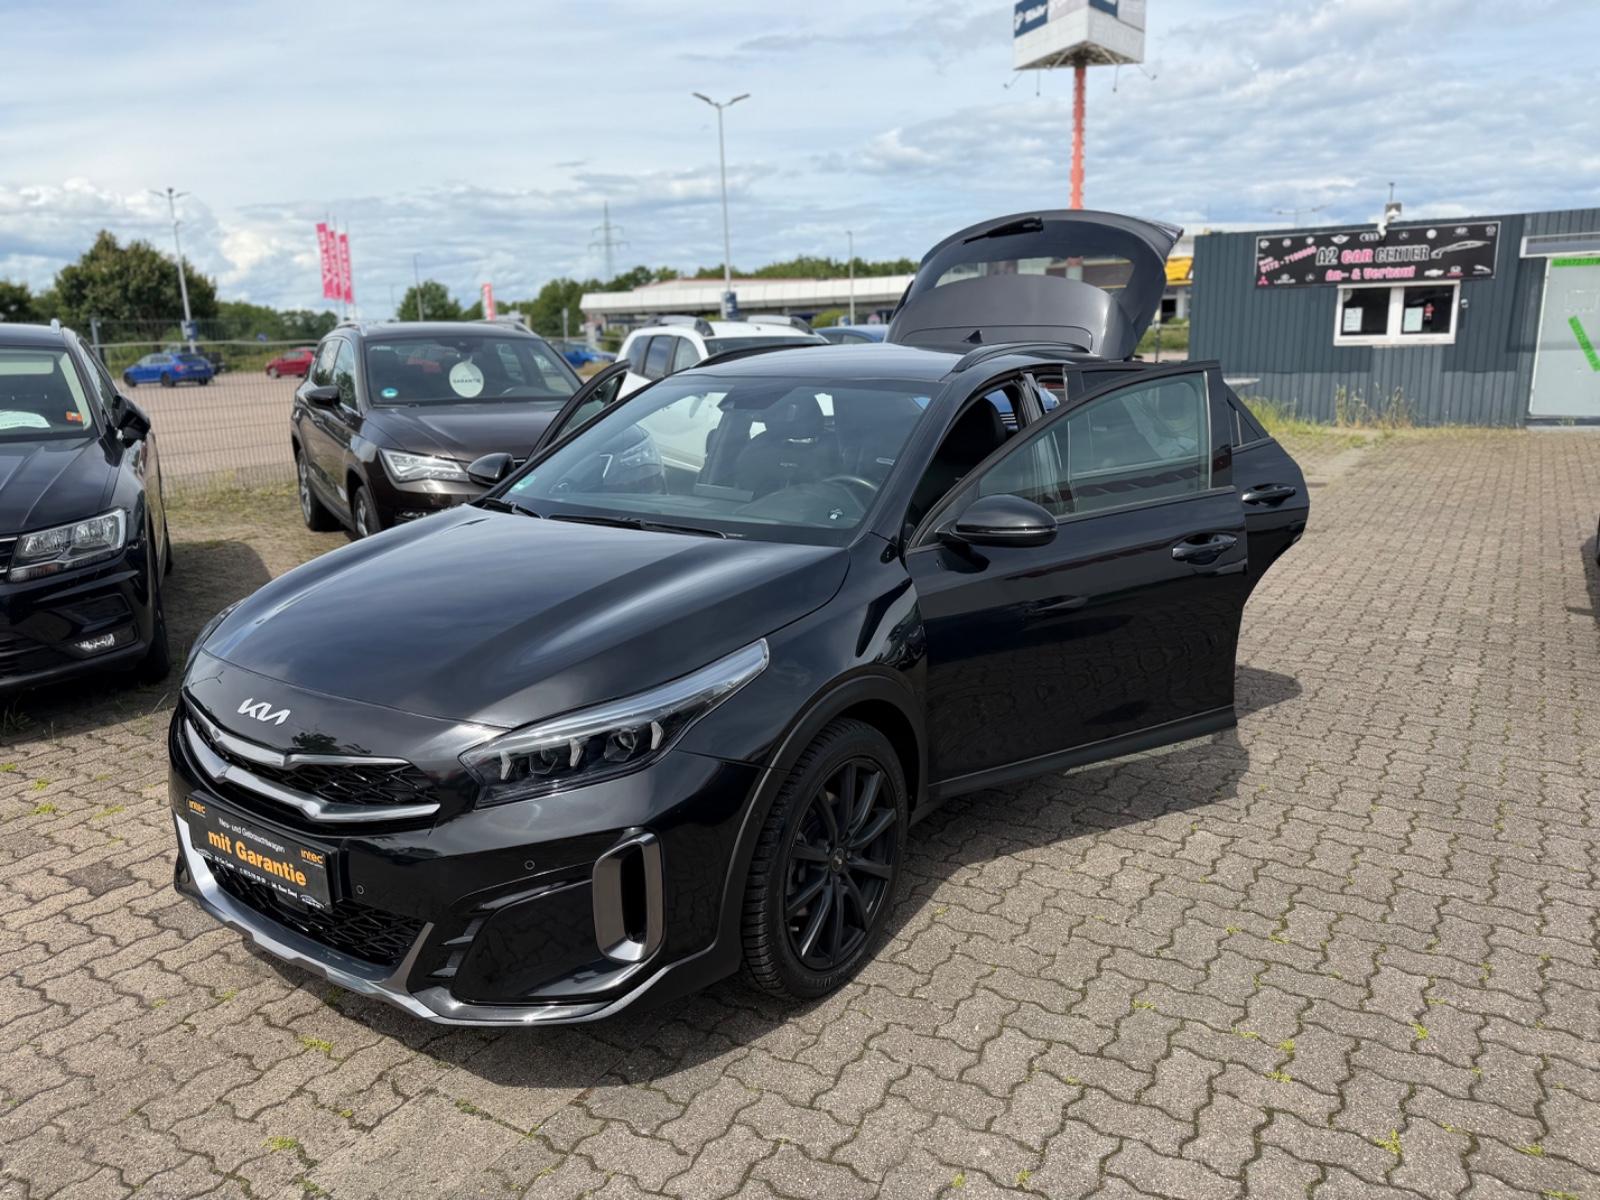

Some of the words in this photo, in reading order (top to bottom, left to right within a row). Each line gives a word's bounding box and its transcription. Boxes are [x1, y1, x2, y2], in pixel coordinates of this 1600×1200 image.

[1341, 248, 1373, 264] CAR
[1375, 244, 1430, 263] CENTER
[237, 697, 291, 726] KIA
[208, 830, 233, 854] mit
[235, 841, 307, 886] Garantie
[301, 849, 325, 864] intec
